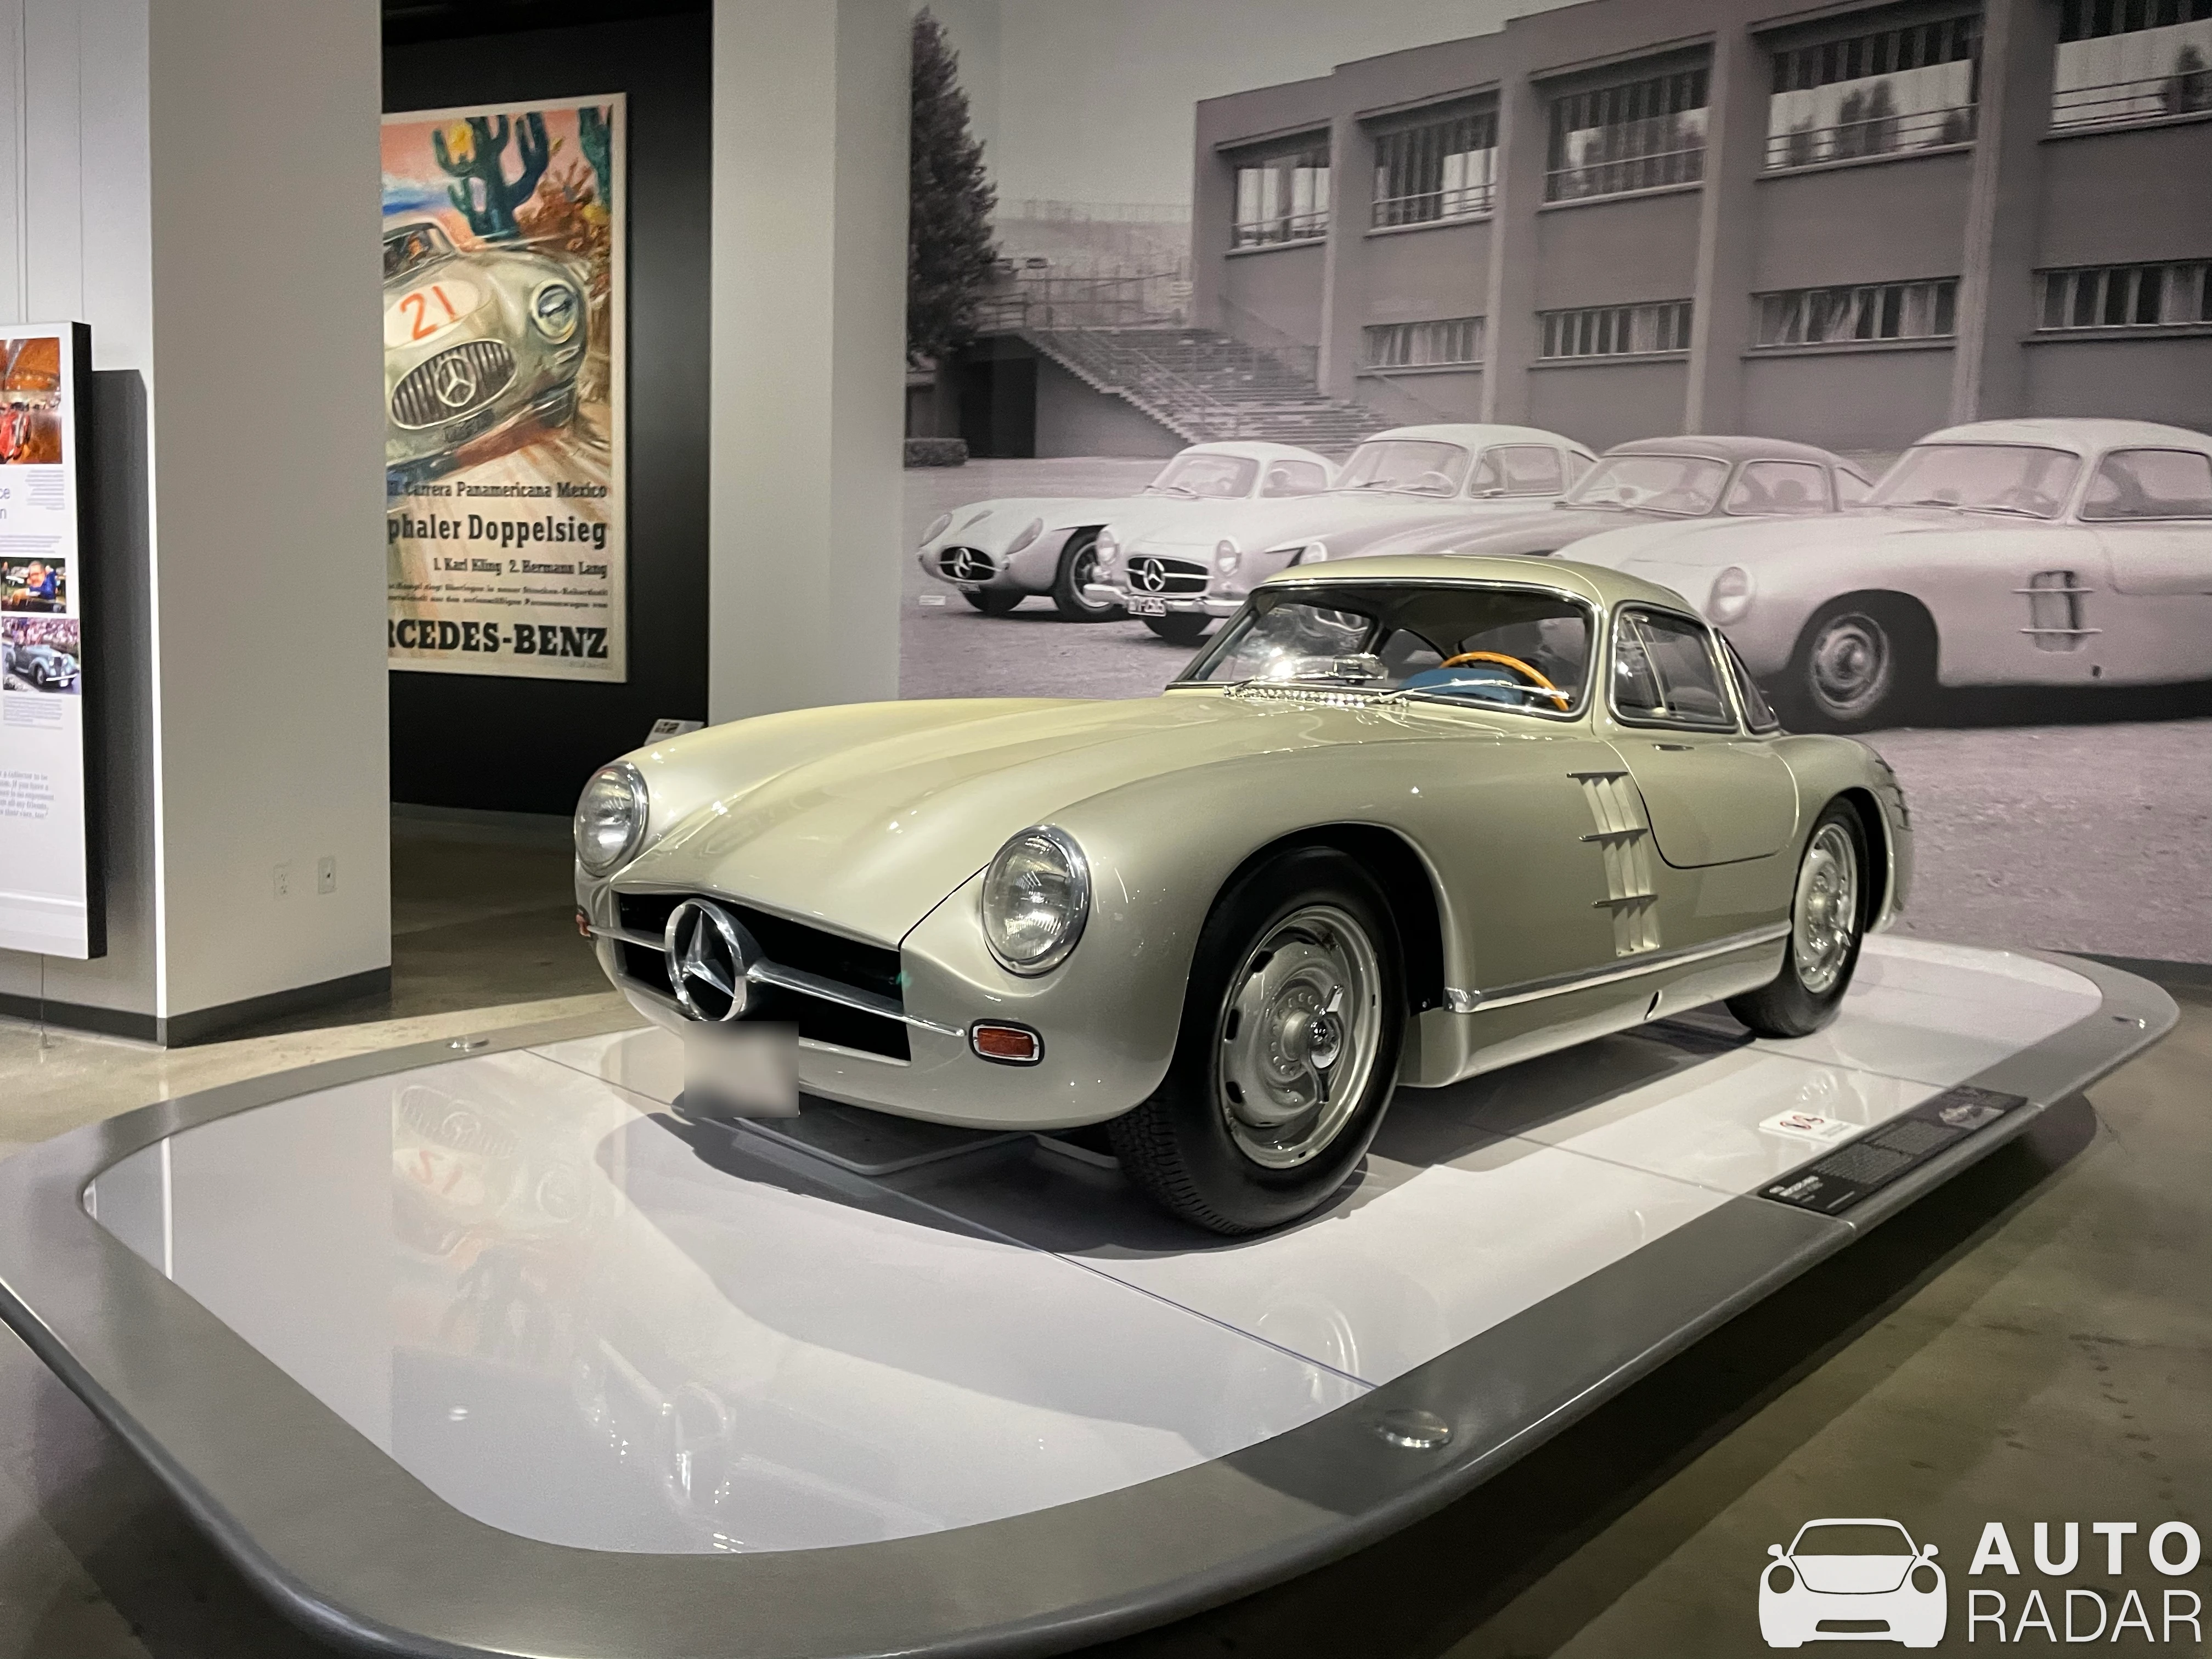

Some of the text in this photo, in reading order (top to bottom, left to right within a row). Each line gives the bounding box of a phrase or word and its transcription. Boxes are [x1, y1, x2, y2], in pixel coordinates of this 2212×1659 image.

[400, 286, 455, 340] 21
[405, 481, 607, 498] Carrera Panamericana Mexico
[388, 514, 606, 550] phaler Doppelsieg
[444, 558, 467, 571] Karl
[472, 558, 502, 576] Kling
[522, 560, 574, 574] Hermann
[579, 561, 607, 579] Lang
